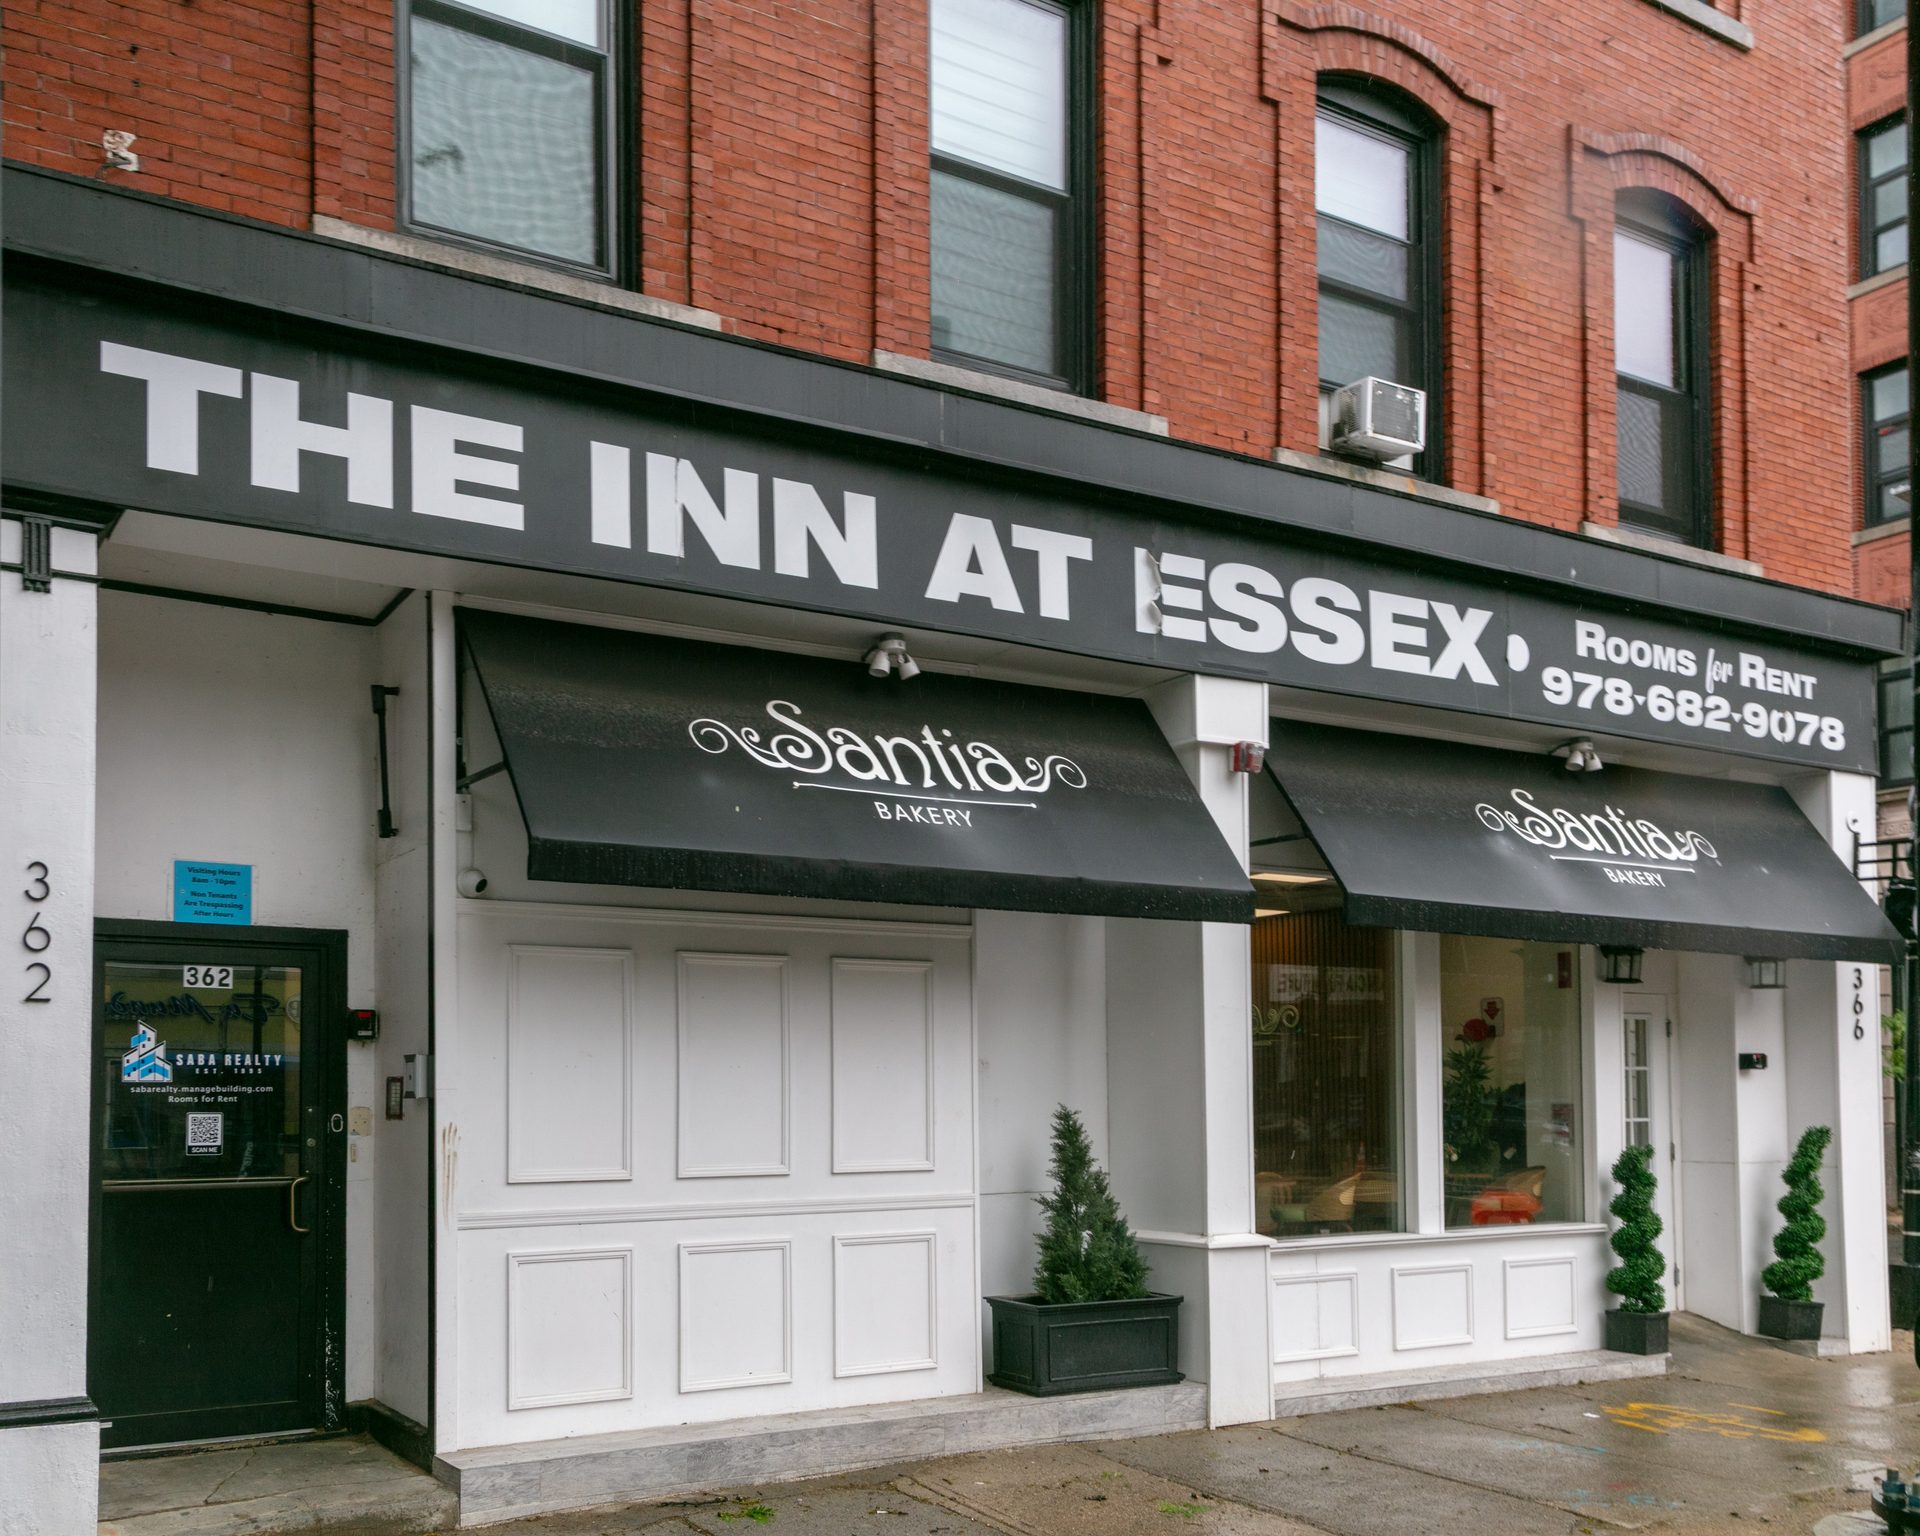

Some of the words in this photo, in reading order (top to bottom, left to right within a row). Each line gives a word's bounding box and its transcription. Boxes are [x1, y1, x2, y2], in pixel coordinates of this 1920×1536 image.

[101, 341, 524, 531] THE
[590, 441, 879, 590] INN
[925, 513, 1093, 620] AT
[1134, 546, 1500, 687] ESSEX
[1705, 648, 1734, 694] for
[689, 700, 1087, 793] Santia
[873, 801, 973, 828] BAKERY
[1475, 788, 1718, 862] Santia
[187, 866, 217, 876] Visiting
[218, 869, 241, 877] Hours
[1603, 867, 1666, 888] BAKERY
[214, 878, 236, 886] 10pm
[208, 891, 237, 900] Tenants
[199, 900, 243, 911] Trespassing
[185, 966, 231, 988] 362
[176, 1053, 217, 1066] SABA
[224, 1054, 283, 1067] REALTY
[130, 1085, 274, 1094] sabarealty.managebuilding.com
[168, 1095, 199, 1103] Rooms
[201, 1095, 215, 1103] for
[217, 1095, 238, 1103] Rent
